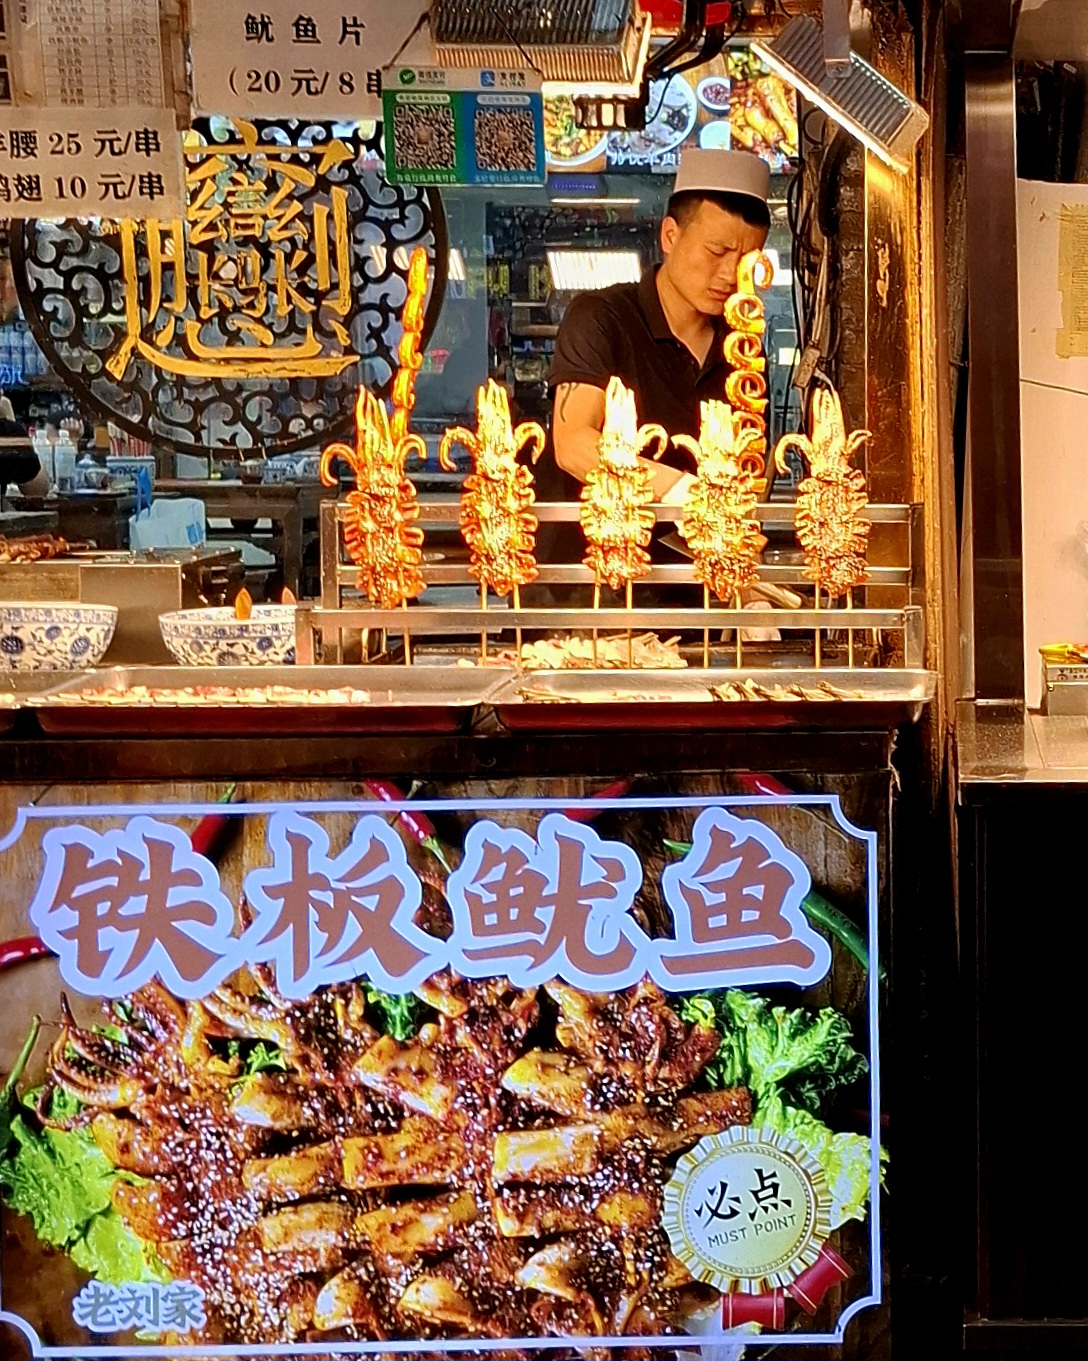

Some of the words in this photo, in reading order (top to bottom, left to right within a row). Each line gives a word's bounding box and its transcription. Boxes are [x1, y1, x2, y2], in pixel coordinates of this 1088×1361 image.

[244, 13, 366, 46] 鱿鱼片
[46, 824, 837, 986] 铁板鱿鱼
[694, 1169, 792, 1229] 必点
[708, 1227, 747, 1248] MUST
[754, 1213, 797, 1237] POINT
[78, 1285, 201, 1328] 老刘家
